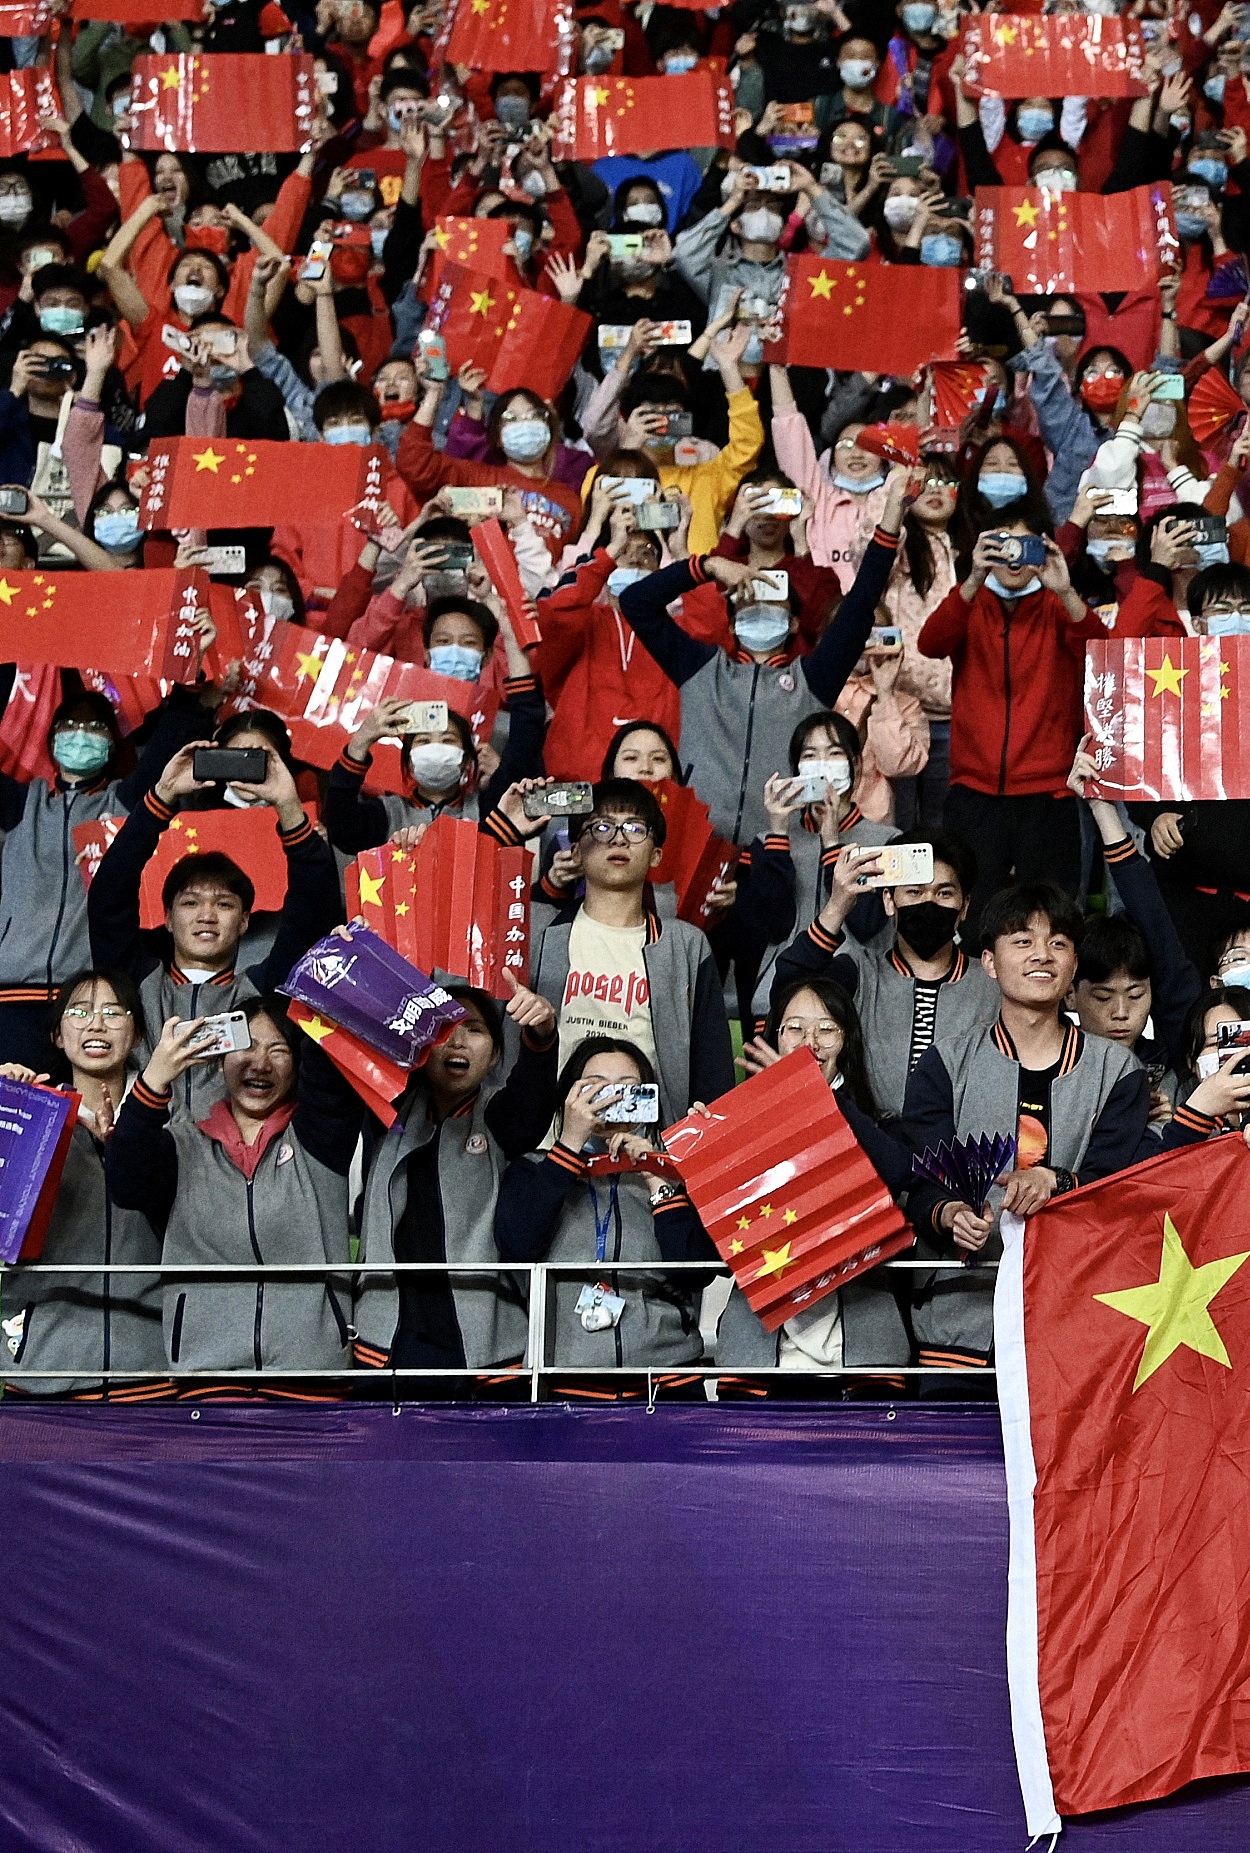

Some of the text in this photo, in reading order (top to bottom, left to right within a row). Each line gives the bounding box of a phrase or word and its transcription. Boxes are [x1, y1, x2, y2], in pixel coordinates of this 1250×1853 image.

[505, 875, 526, 968] 中国加油
[566, 1016, 629, 1030] JUSTIN BIEBER
